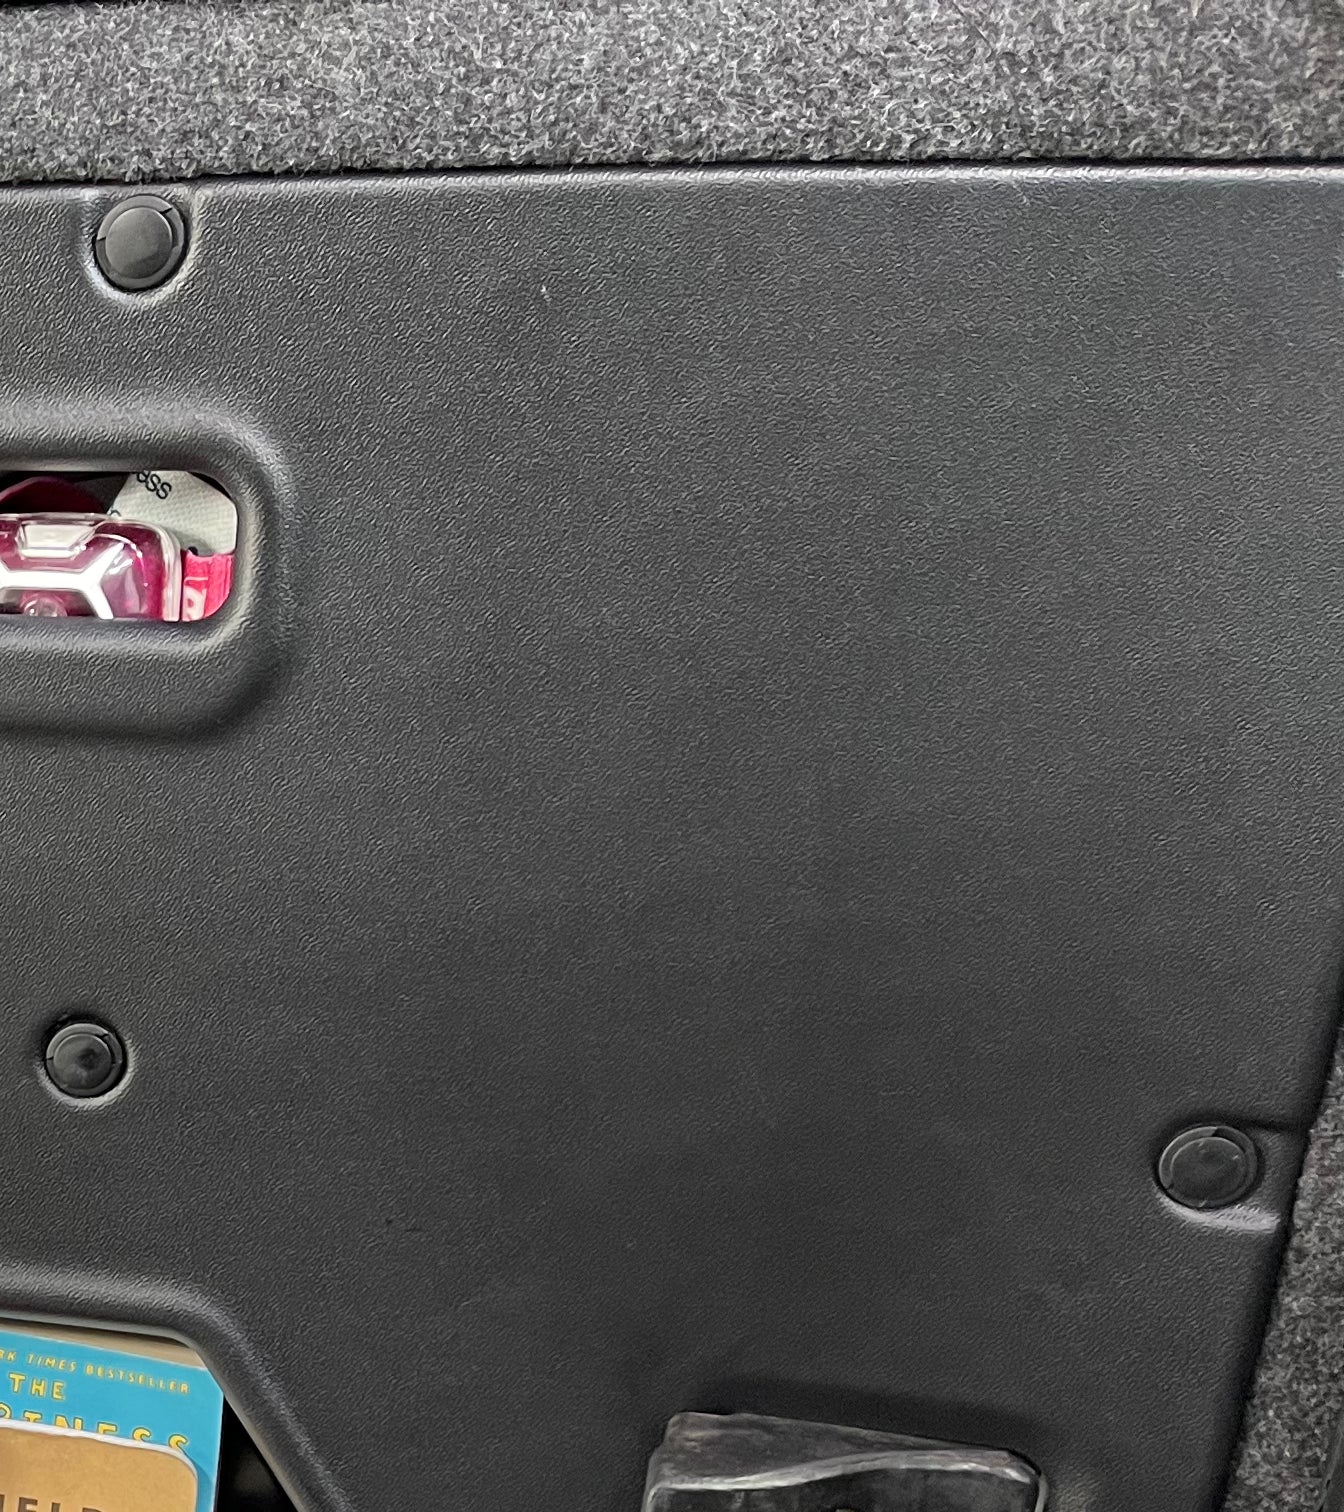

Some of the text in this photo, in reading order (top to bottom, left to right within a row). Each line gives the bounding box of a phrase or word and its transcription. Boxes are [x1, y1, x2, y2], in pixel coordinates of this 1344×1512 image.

[9, 1372, 67, 1401] THE
[27, 1352, 77, 1373] TIMES
[85, 1363, 191, 1395] BESTSELLER
